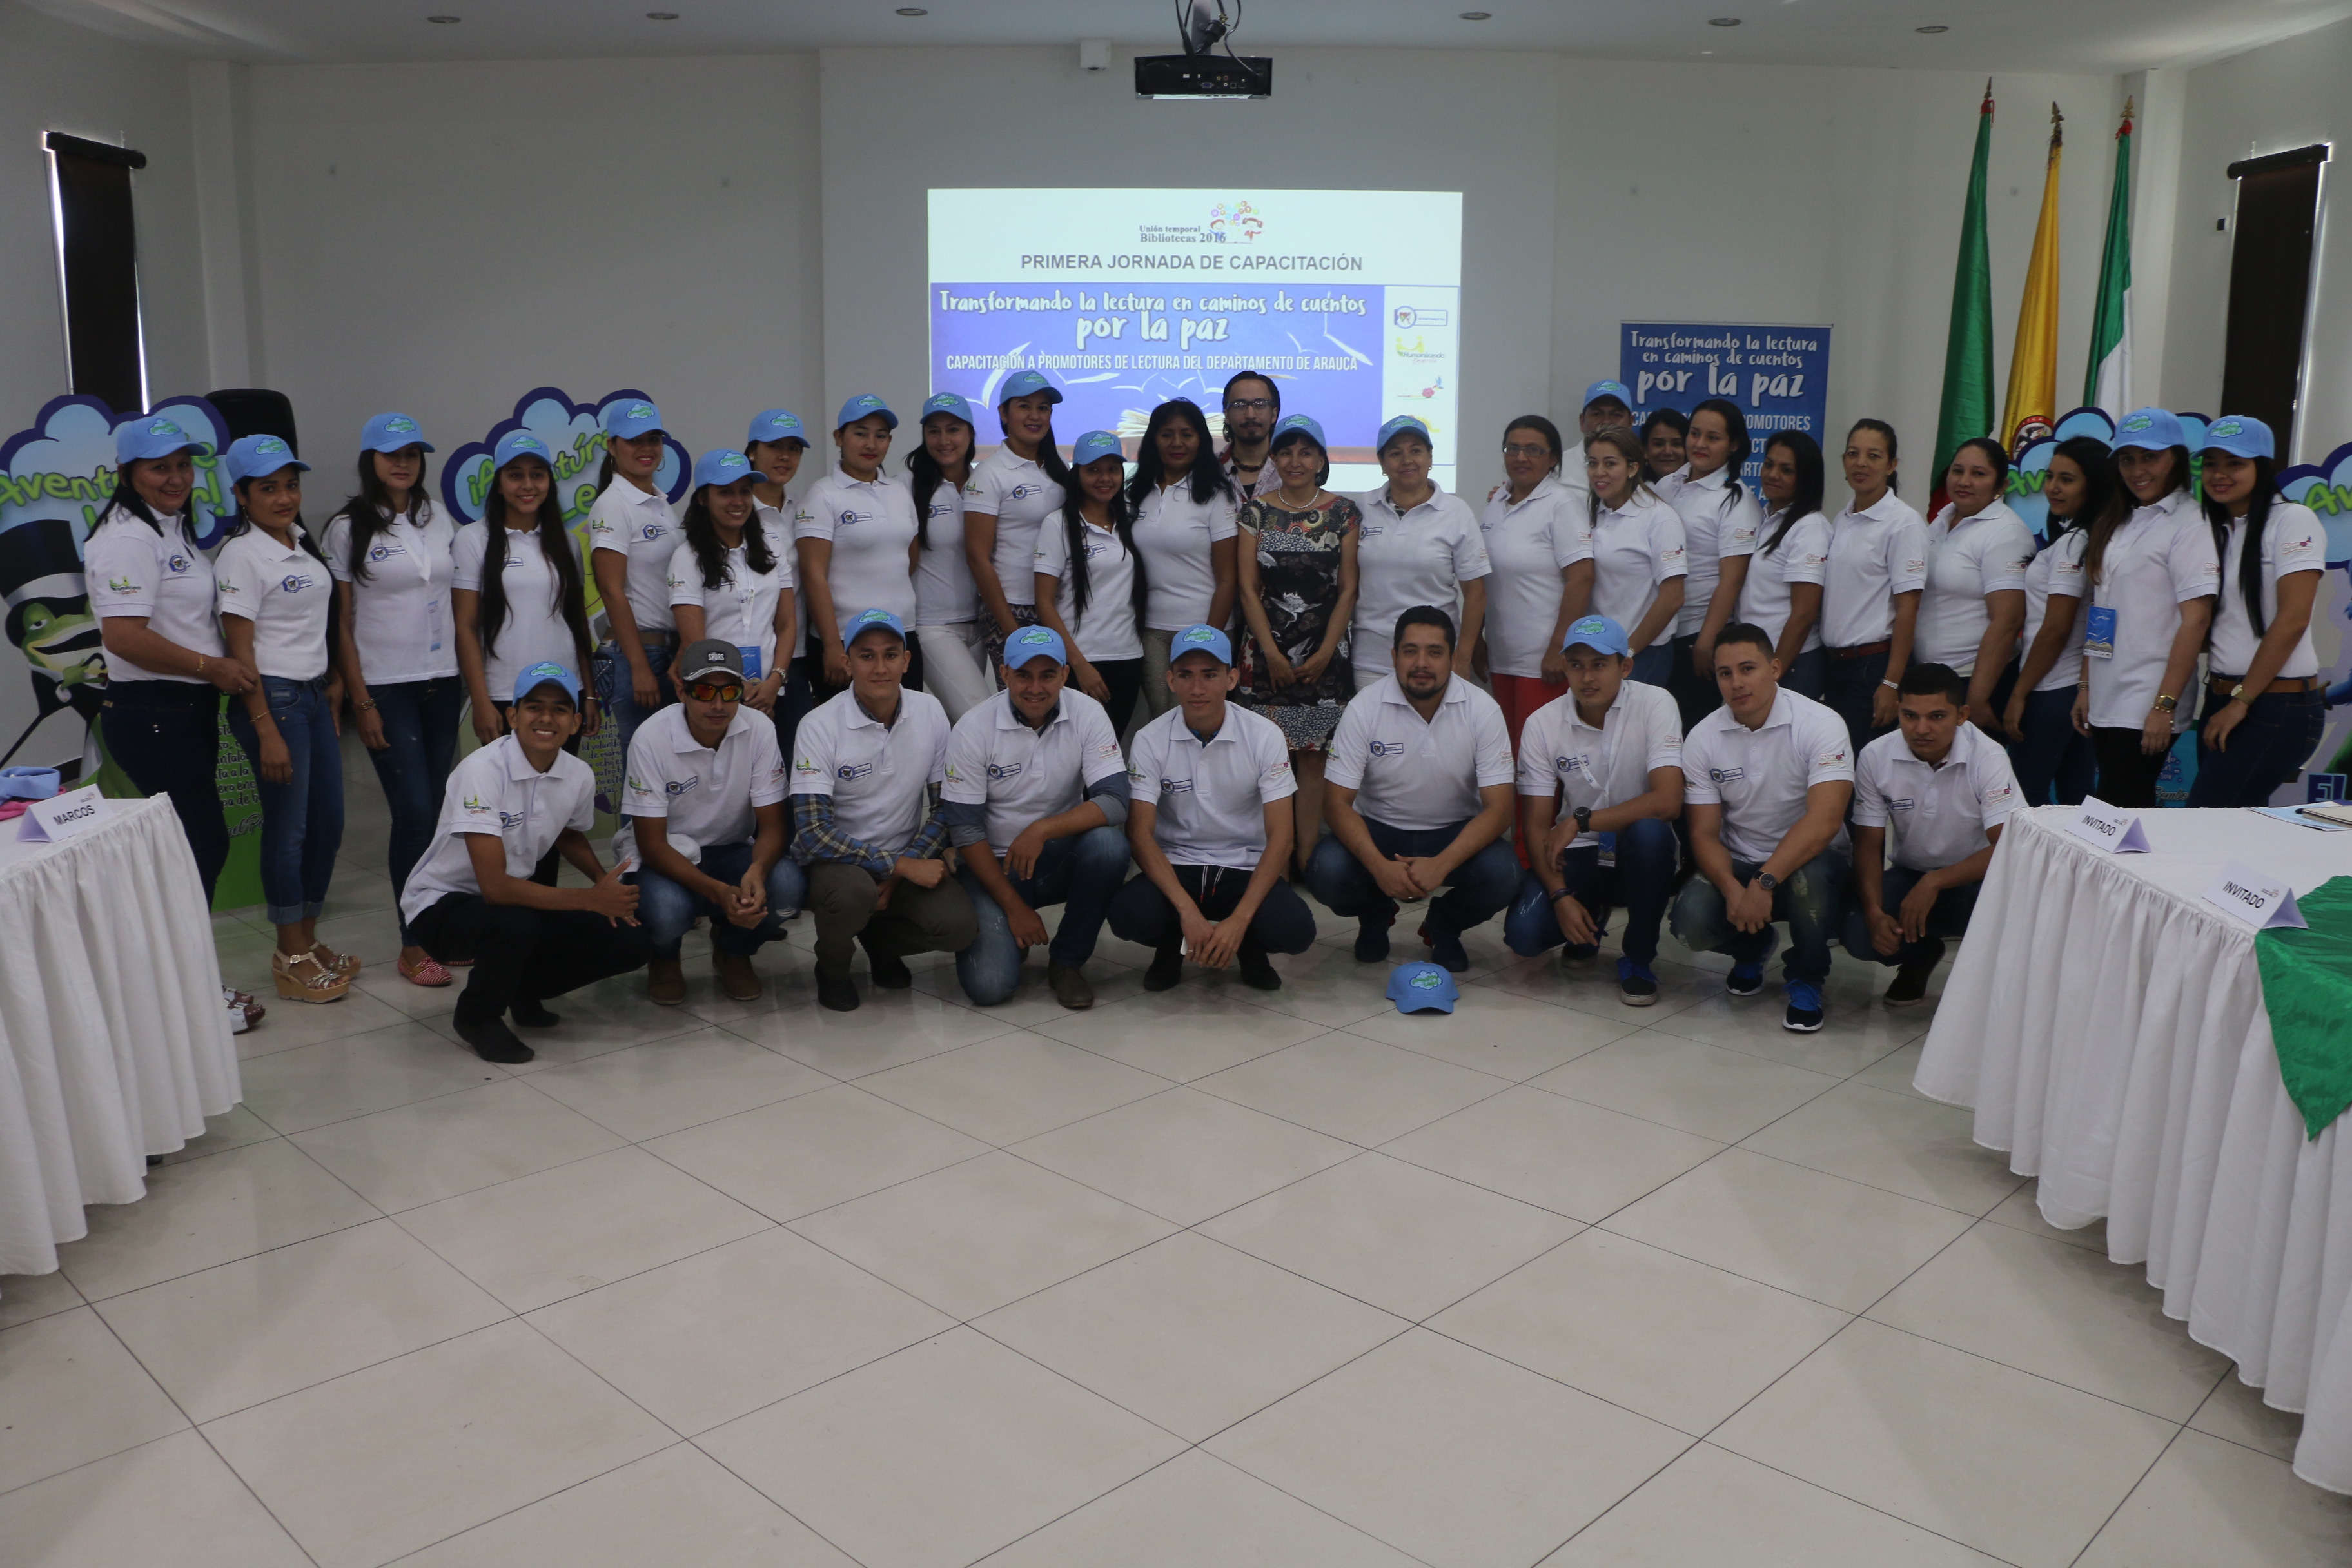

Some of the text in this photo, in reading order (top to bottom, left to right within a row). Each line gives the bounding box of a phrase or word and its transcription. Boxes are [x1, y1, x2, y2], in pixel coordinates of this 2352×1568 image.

[1140, 233, 1226, 243] Bibliotecas 2016
[1164, 226, 1200, 235] temporal
[1021, 252, 1362, 271] PRIMERA JORNADA DE CAPACITACIÓN
[939, 289, 1367, 316] Transformando la lectura en caminos de cuentos
[1075, 309, 1230, 352] por la paz
[1631, 331, 1818, 351] Transformando la lectura
[946, 352, 1358, 371] CAPACITACIÓN A PROMOTORES DE LECTURA DEL DEPARTAMENTO DE ARAUCA
[1643, 348, 1803, 368] en caminos de cuentos
[1636, 363, 1805, 407] por la paz
[1743, 414, 1812, 431] OMOTORES
[53, 805, 95, 826] MARCOS
[2081, 814, 2116, 836] INVITADO
[2222, 881, 2265, 909] INVITADO
